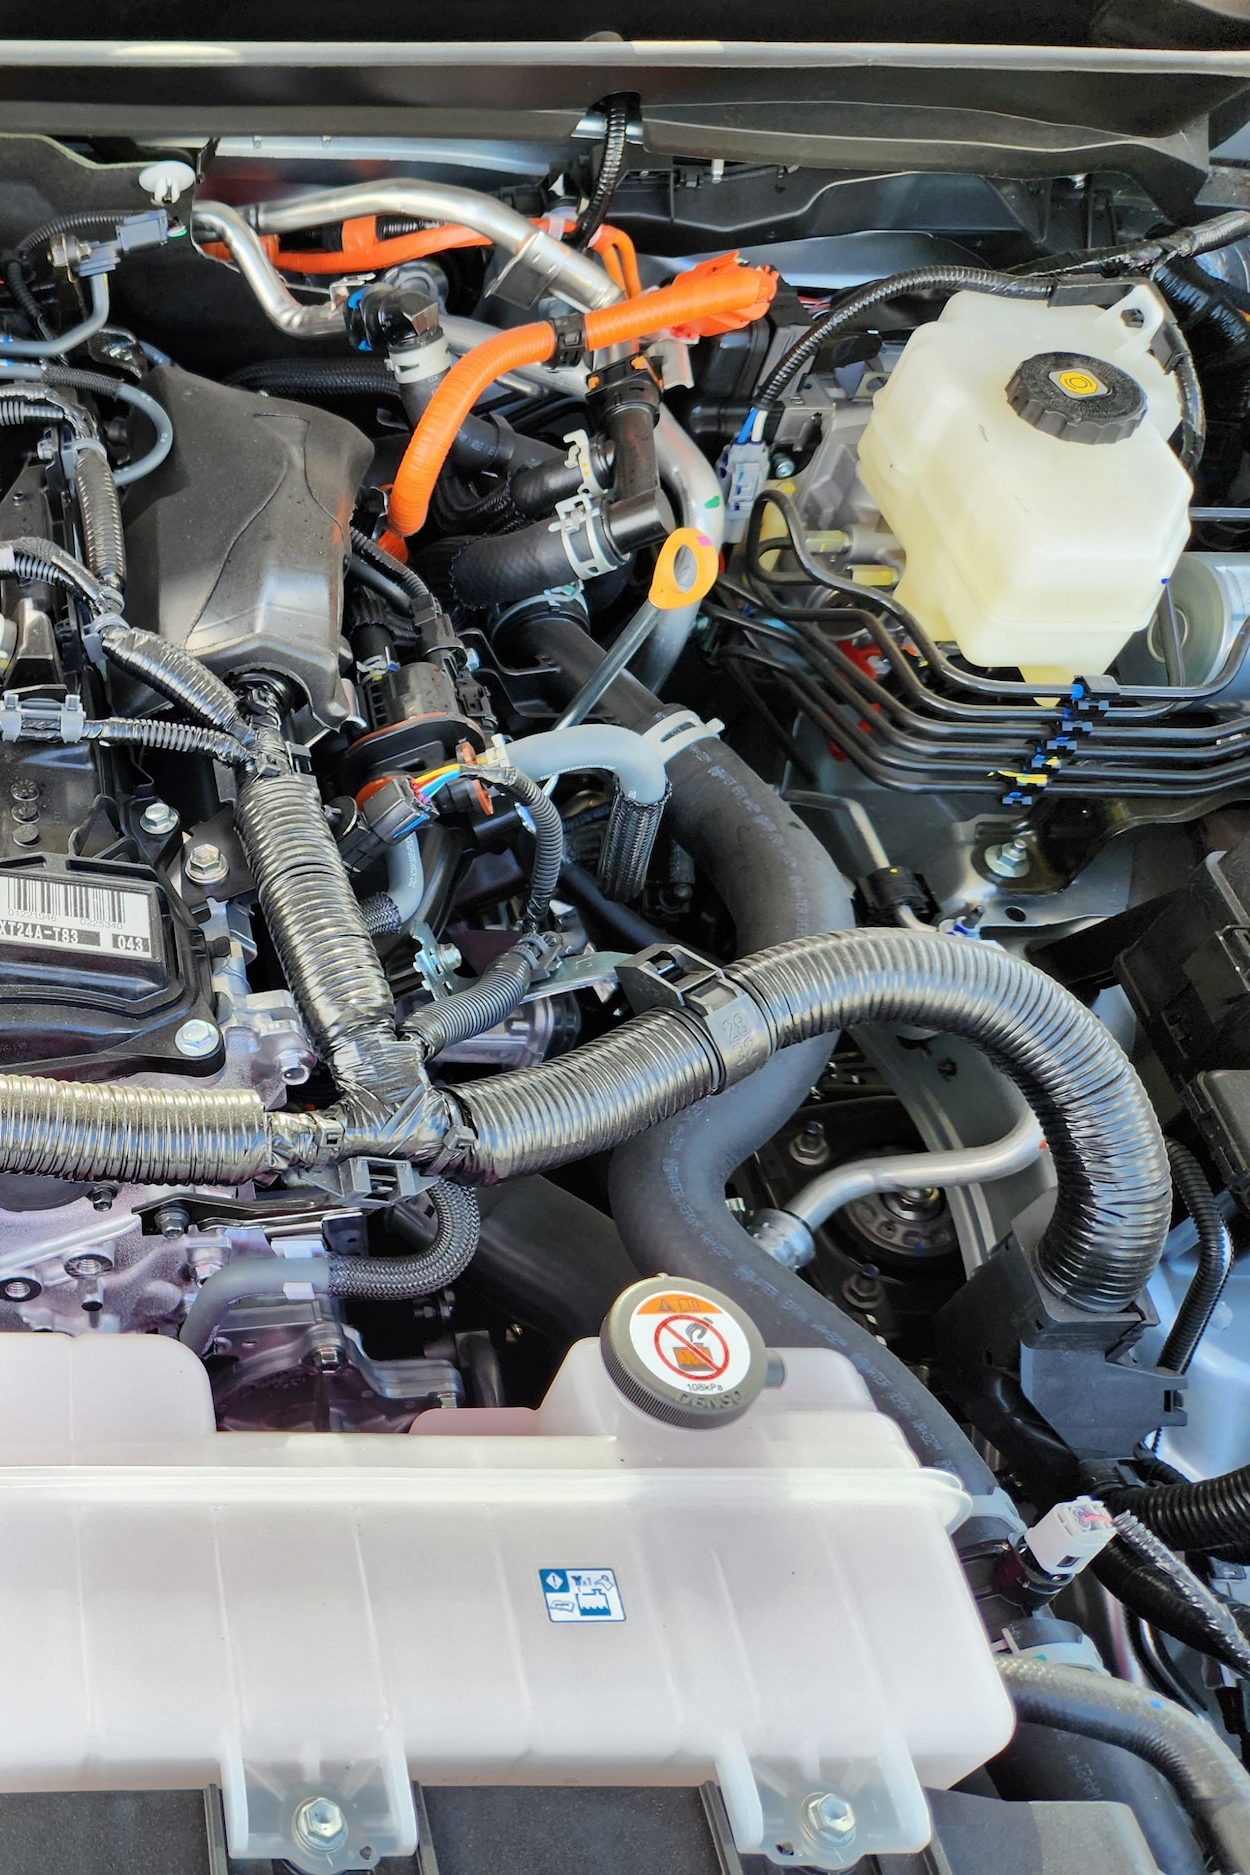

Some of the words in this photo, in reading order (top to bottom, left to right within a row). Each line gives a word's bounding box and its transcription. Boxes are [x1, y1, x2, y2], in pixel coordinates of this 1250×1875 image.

[0, 920, 79, 944] XT24A-T83
[117, 935, 144, 951] 043
[686, 1382, 724, 1392] 108kPa
[674, 1390, 742, 1409] DENSO
